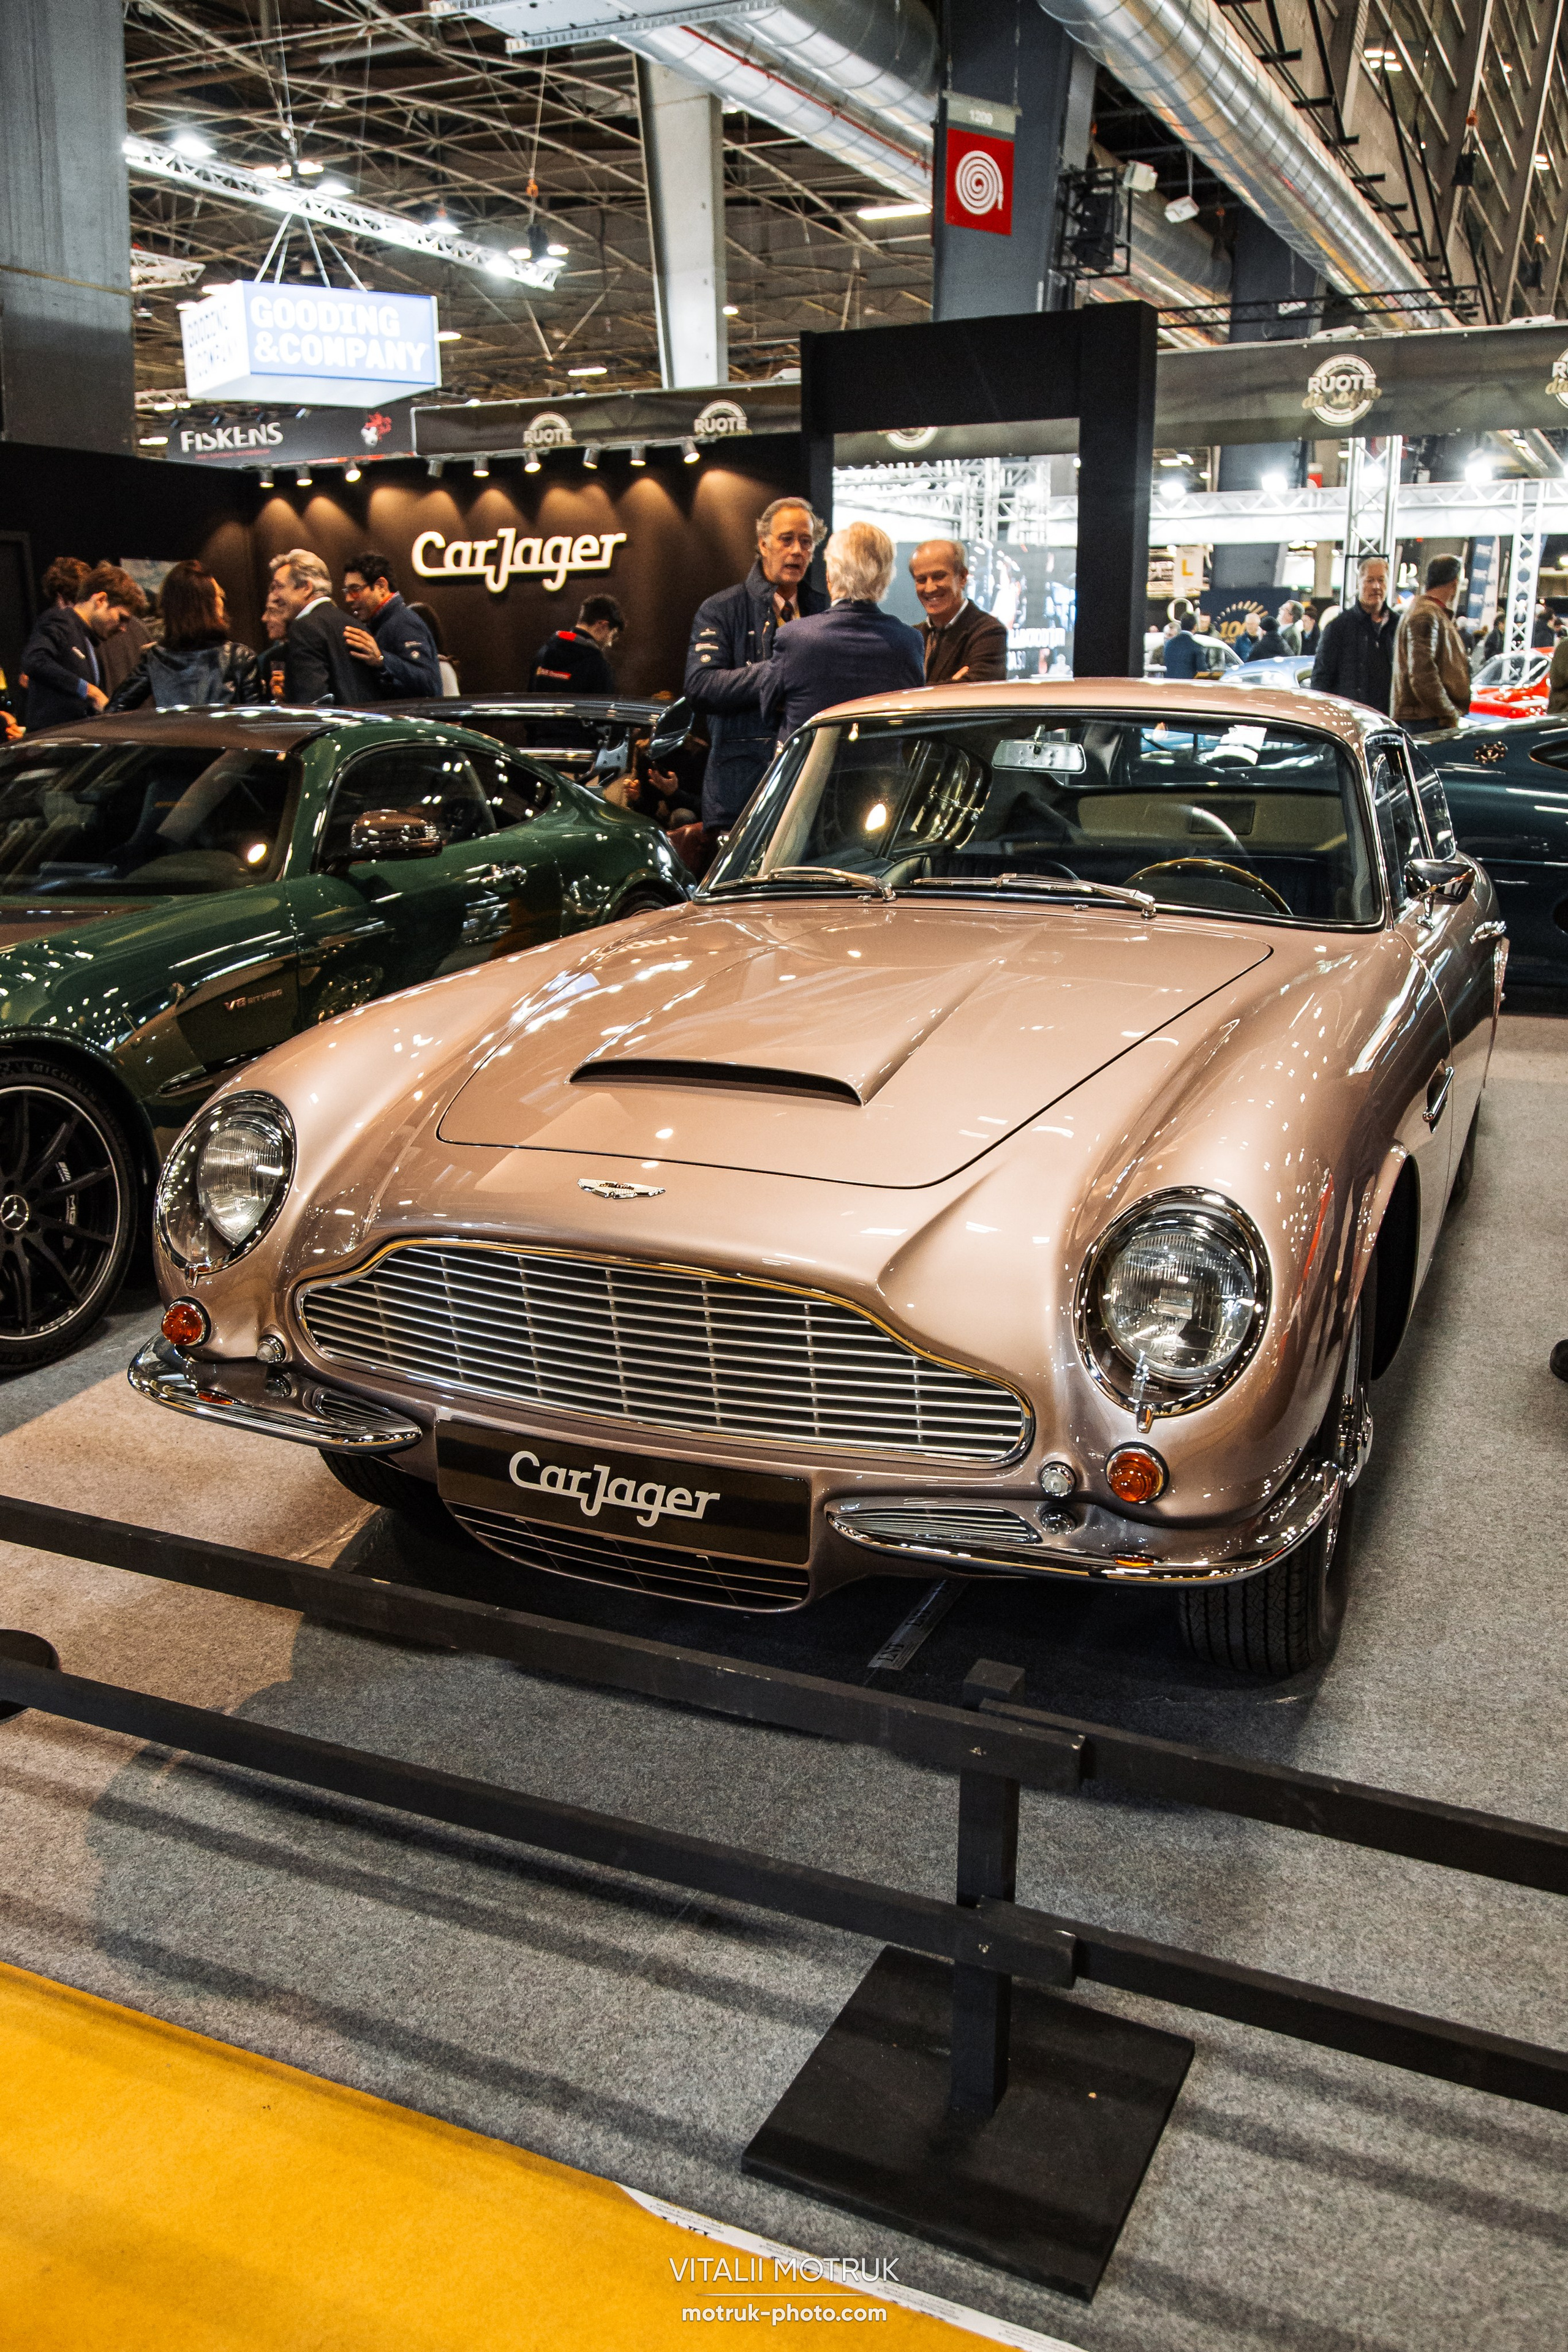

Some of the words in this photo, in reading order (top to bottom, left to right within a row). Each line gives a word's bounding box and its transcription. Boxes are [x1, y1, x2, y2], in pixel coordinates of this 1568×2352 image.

[250, 296, 400, 337] GOODING
[254, 331, 426, 372] &COMPANY
[1308, 373, 1376, 394] RUOTE
[523, 428, 573, 445] RUOTE
[693, 417, 748, 434] RUOTE
[412, 527, 628, 594] CarJager
[509, 1450, 720, 1528] CarJager
